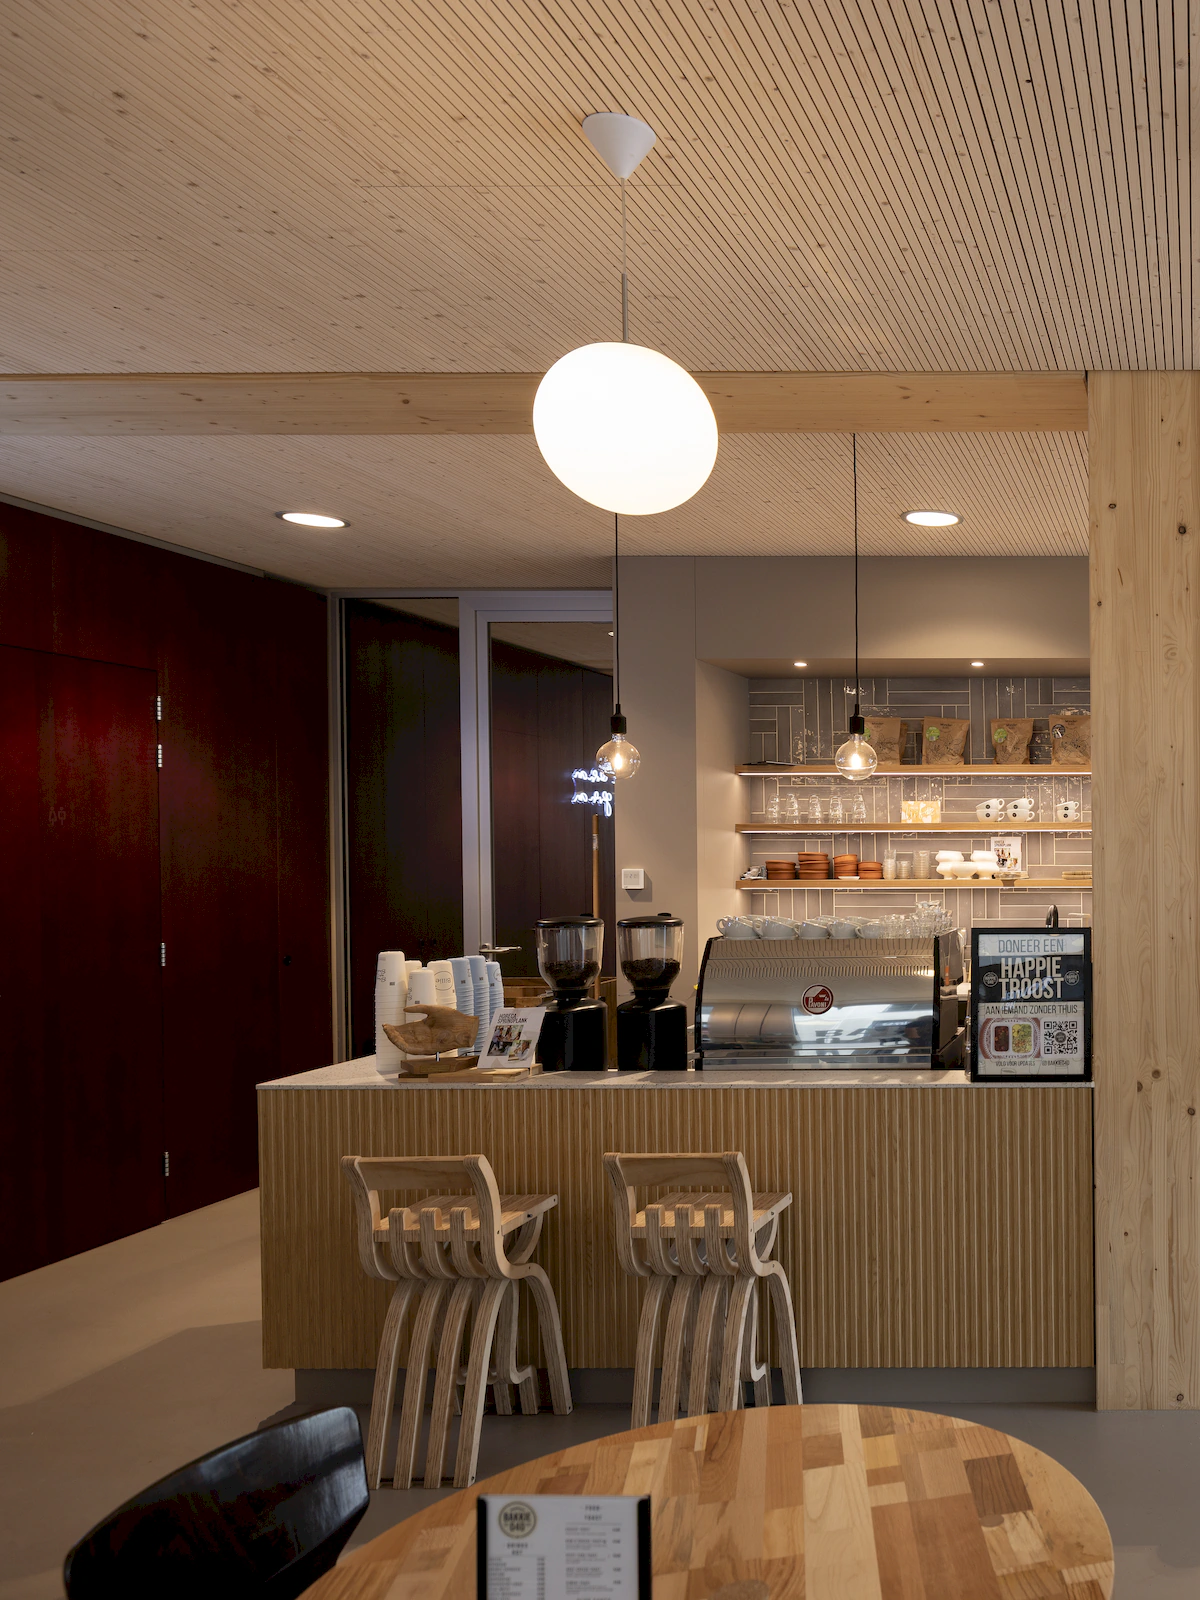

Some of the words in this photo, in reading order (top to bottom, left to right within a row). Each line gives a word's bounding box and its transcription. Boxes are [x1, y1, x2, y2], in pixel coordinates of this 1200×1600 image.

[998, 939, 1040, 953] DONEER
[1043, 939, 1064, 952] EEN
[1001, 957, 1061, 978] HAPPIE
[999, 978, 1064, 999] TROOST
[808, 997, 827, 1008] PAVONI
[986, 1005, 1001, 1015] AAN
[1002, 1005, 1027, 1014] IEMAND
[1029, 1005, 1057, 1014] ZONDER
[1058, 1005, 1078, 1014] THUIS
